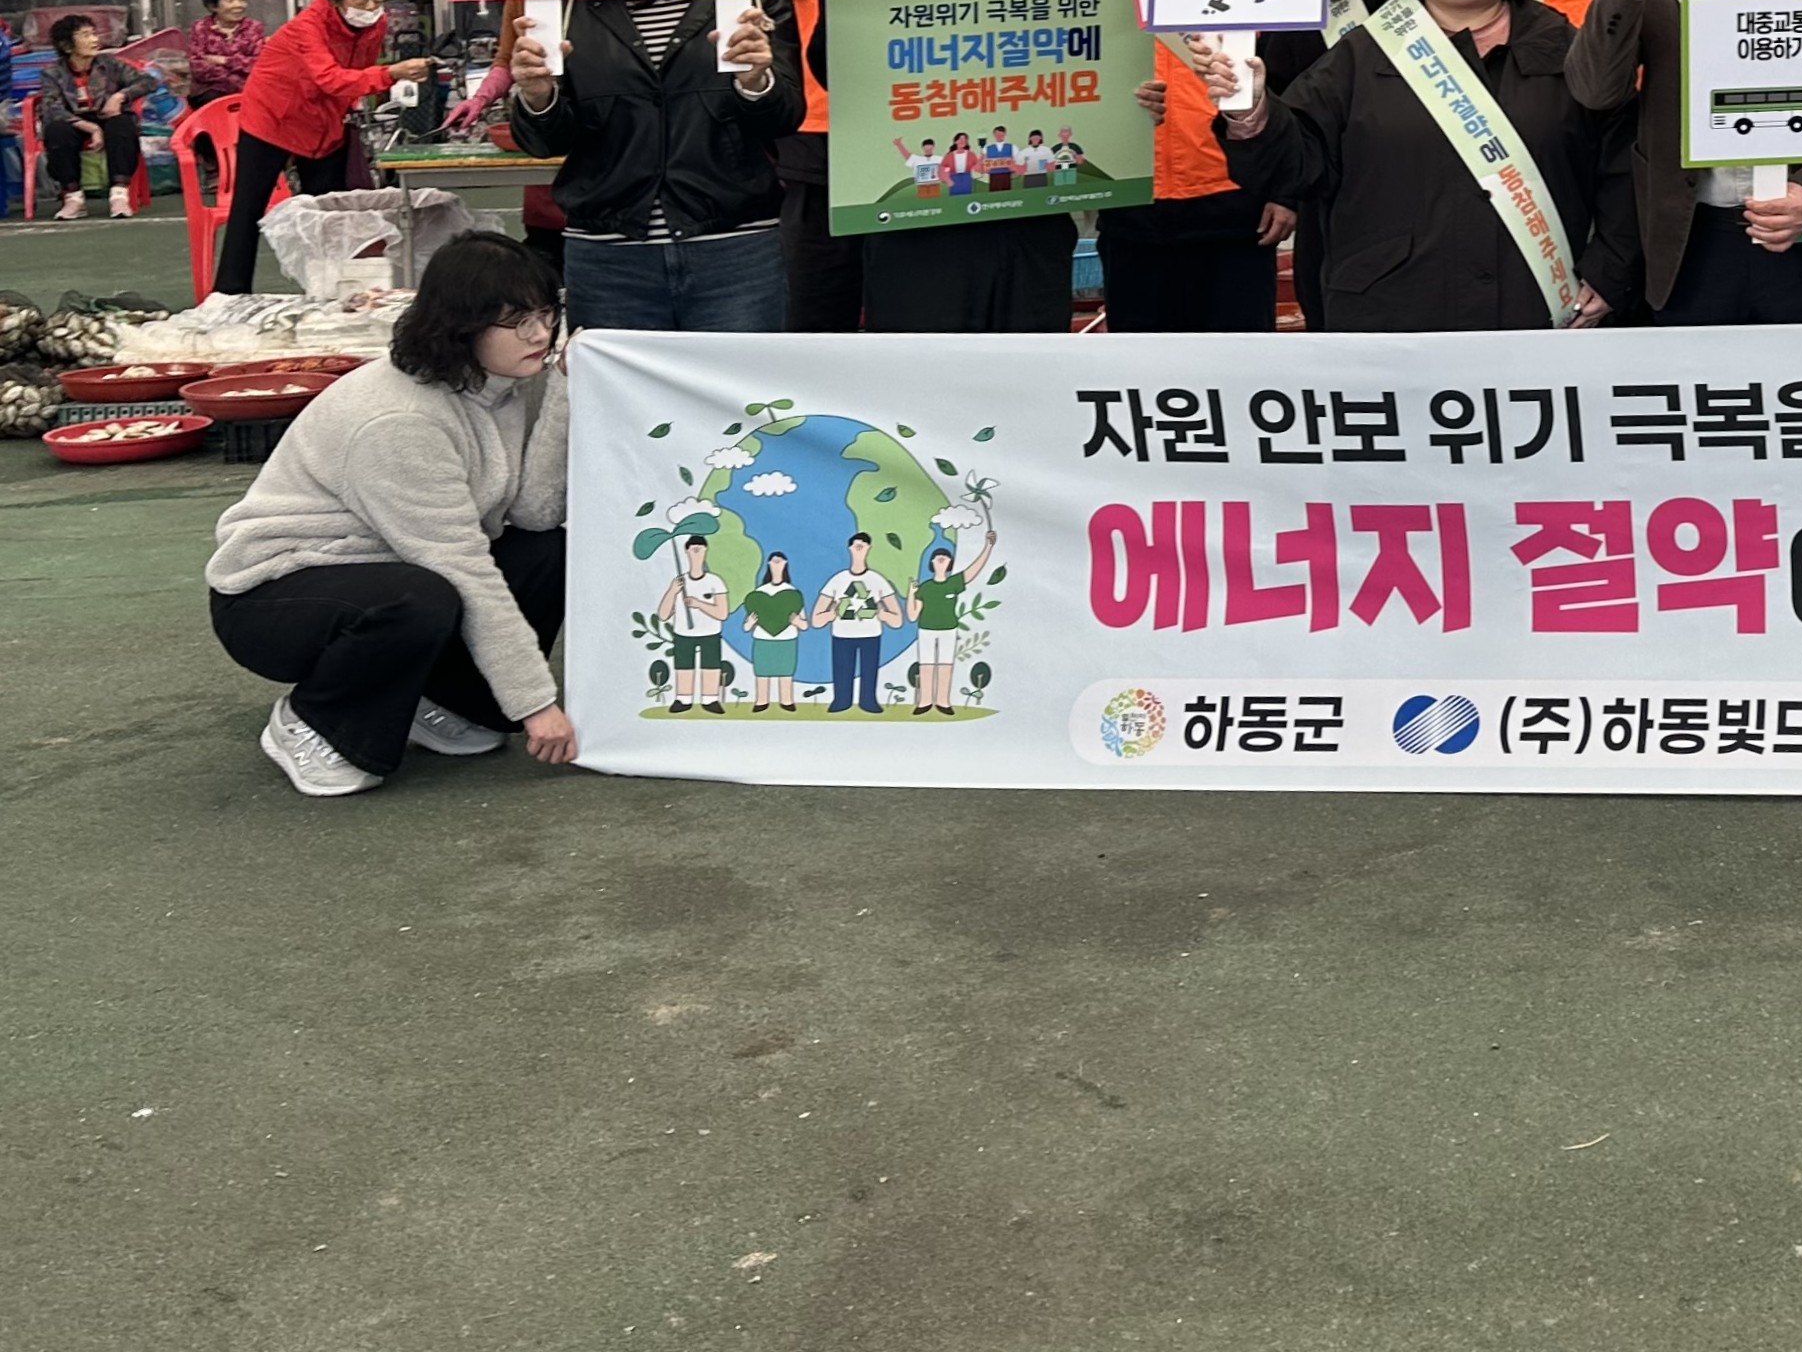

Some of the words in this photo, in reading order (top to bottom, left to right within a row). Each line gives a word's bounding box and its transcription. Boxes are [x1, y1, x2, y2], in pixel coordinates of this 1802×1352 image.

[887, 0, 981, 30] 자원위기
[887, 24, 1102, 74] 에너지절약에
[888, 69, 1102, 122] 동참해주세요
[1075, 388, 1230, 464] 자원
[1248, 388, 1407, 465] 안보
[1428, 385, 1585, 465] 위기
[1087, 500, 1472, 634] 에너지
[1183, 695, 1345, 753] 하동군
